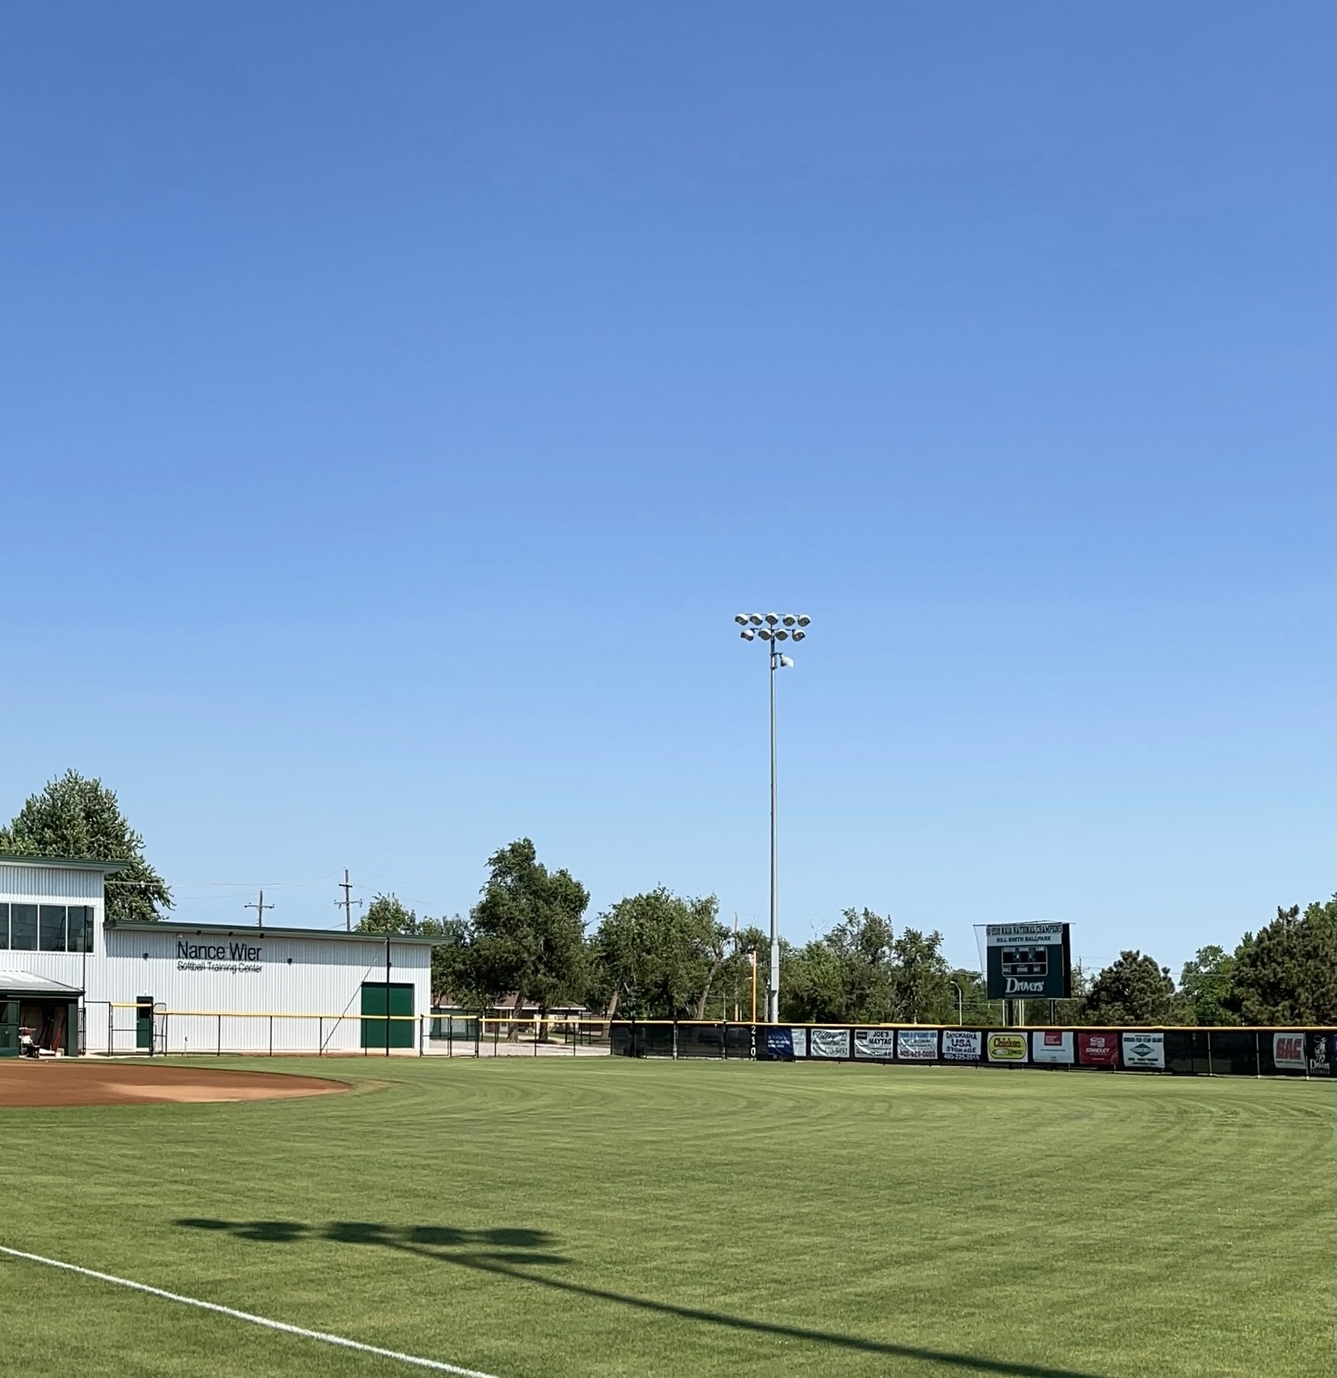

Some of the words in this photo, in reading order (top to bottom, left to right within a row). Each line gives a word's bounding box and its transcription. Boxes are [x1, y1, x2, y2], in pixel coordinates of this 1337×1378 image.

[177, 940, 225, 960] Nance
[229, 942, 262, 961] Wier
[177, 960, 206, 971] Softball
[207, 961, 237, 974] Training
[239, 962, 262, 973] Center
[946, 1031, 978, 1041] CHICKASHA
[951, 1039, 973, 1048] USA
[993, 1037, 1021, 1048] Chicken
